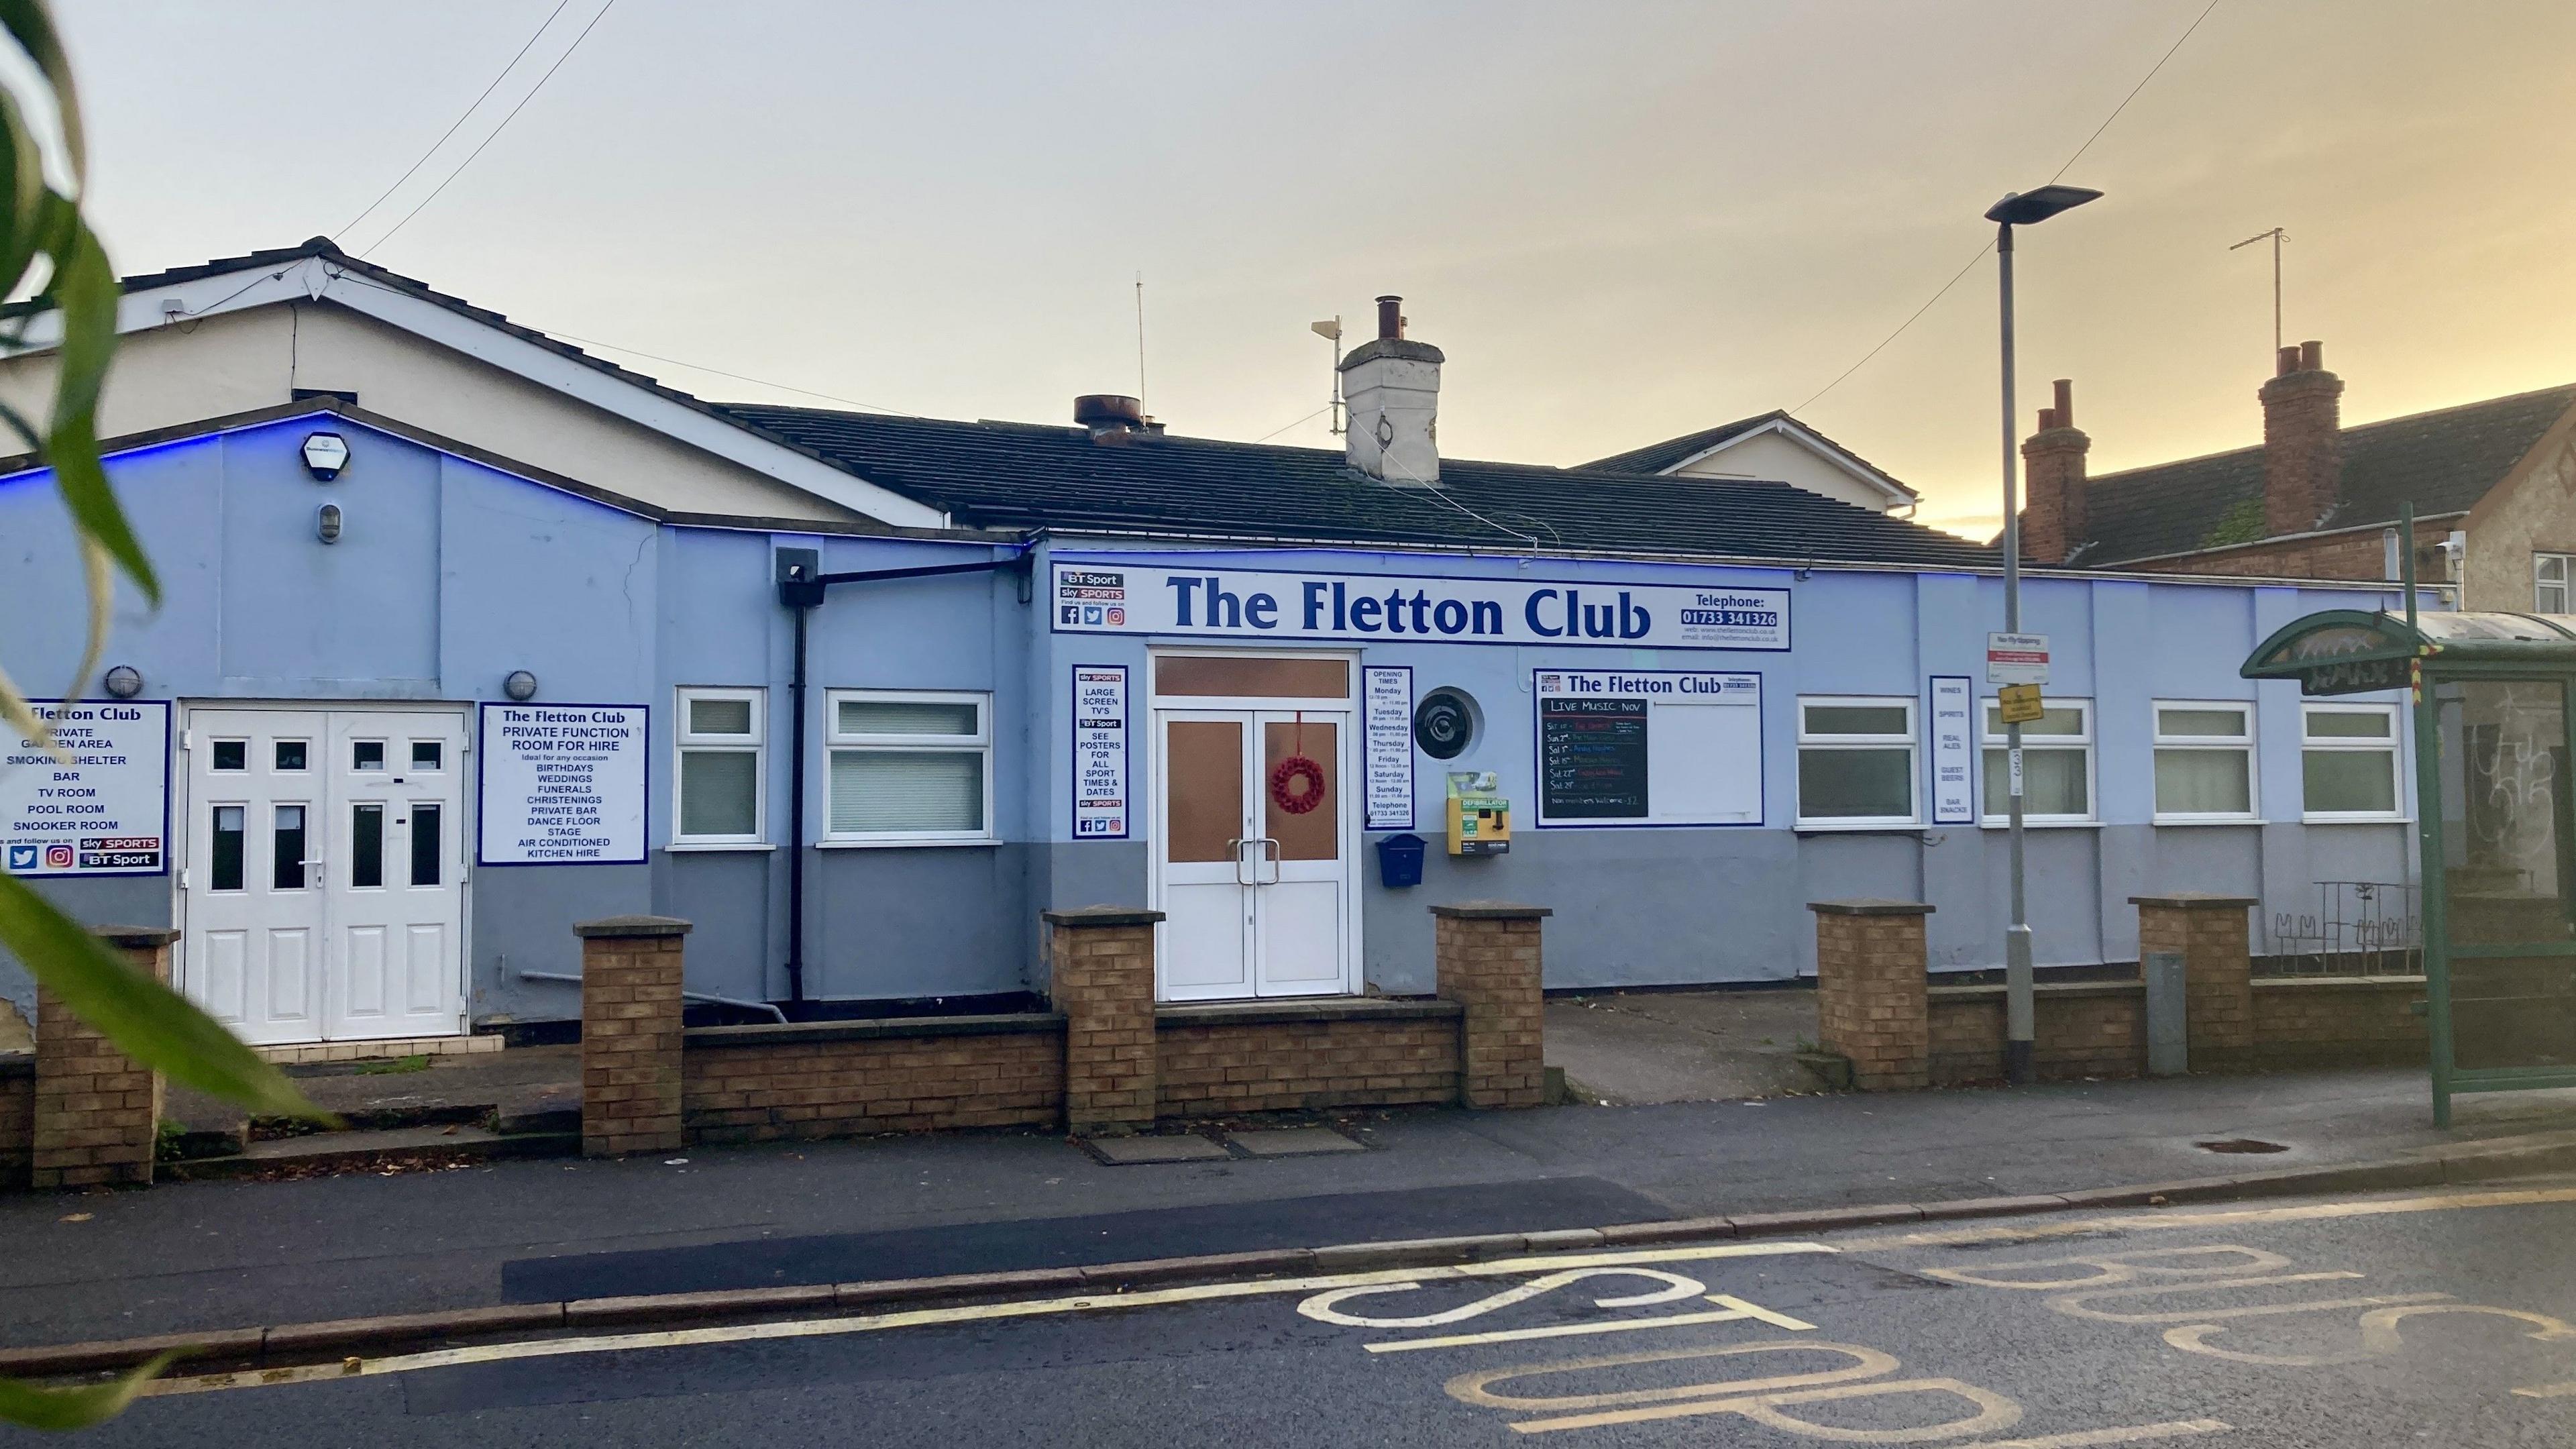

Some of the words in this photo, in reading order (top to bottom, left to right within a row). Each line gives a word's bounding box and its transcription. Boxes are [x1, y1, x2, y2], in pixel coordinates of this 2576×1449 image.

[1068, 575, 1085, 583] BT
[1087, 575, 1116, 585] Sport
[1062, 588, 1078, 597] sky
[1081, 590, 1122, 598] SPORTS
[1697, 594, 1764, 609] Telephone:
[1166, 576, 1278, 629] The
[1301, 581, 1503, 635] Fletton
[1524, 589, 1652, 639] Club
[1682, 611, 1723, 623] 01733
[1728, 612, 1776, 625] 341326
[1568, 676, 1602, 692] The
[1609, 676, 1672, 693] Fletton
[1679, 677, 1721, 694] Club
[1551, 700, 1576, 711] LIVE
[1582, 702, 1616, 710] MUSIC
[1622, 703, 1640, 711] NOV
[101, 708, 141, 720] Club
[504, 710, 530, 722] The
[535, 711, 587, 722] Fletton
[592, 712, 625, 722] Club
[1375, 708, 1402, 716] Tuesday
[503, 727, 557, 737] PRIVATE
[563, 728, 629, 738] FUNCTION
[79, 740, 112, 748] AREA
[512, 741, 553, 750] ROOM
[557, 741, 584, 751] FOR
[590, 741, 619, 751] HIRE
[70, 756, 126, 765] SHELTER
[537, 764, 593, 772] BIRTHDAYS
[54, 772, 80, 781] BAR
[38, 789, 54, 797] TV
[58, 789, 95, 797] ROOM
[28, 805, 62, 814] POOL
[67, 805, 105, 813] ROOM
[13, 822, 76, 830] SNOOKER
[80, 821, 118, 829] ROOM
[83, 839, 102, 849] sky
[106, 839, 156, 848] SPORTS
[539, 839, 610, 847] CONDITIONED
[89, 855, 111, 865] BT
[113, 855, 150, 867] Sport
[1920, 1244, 2576, 1366] BUS
[1297, 1267, 2023, 1443] STOP
